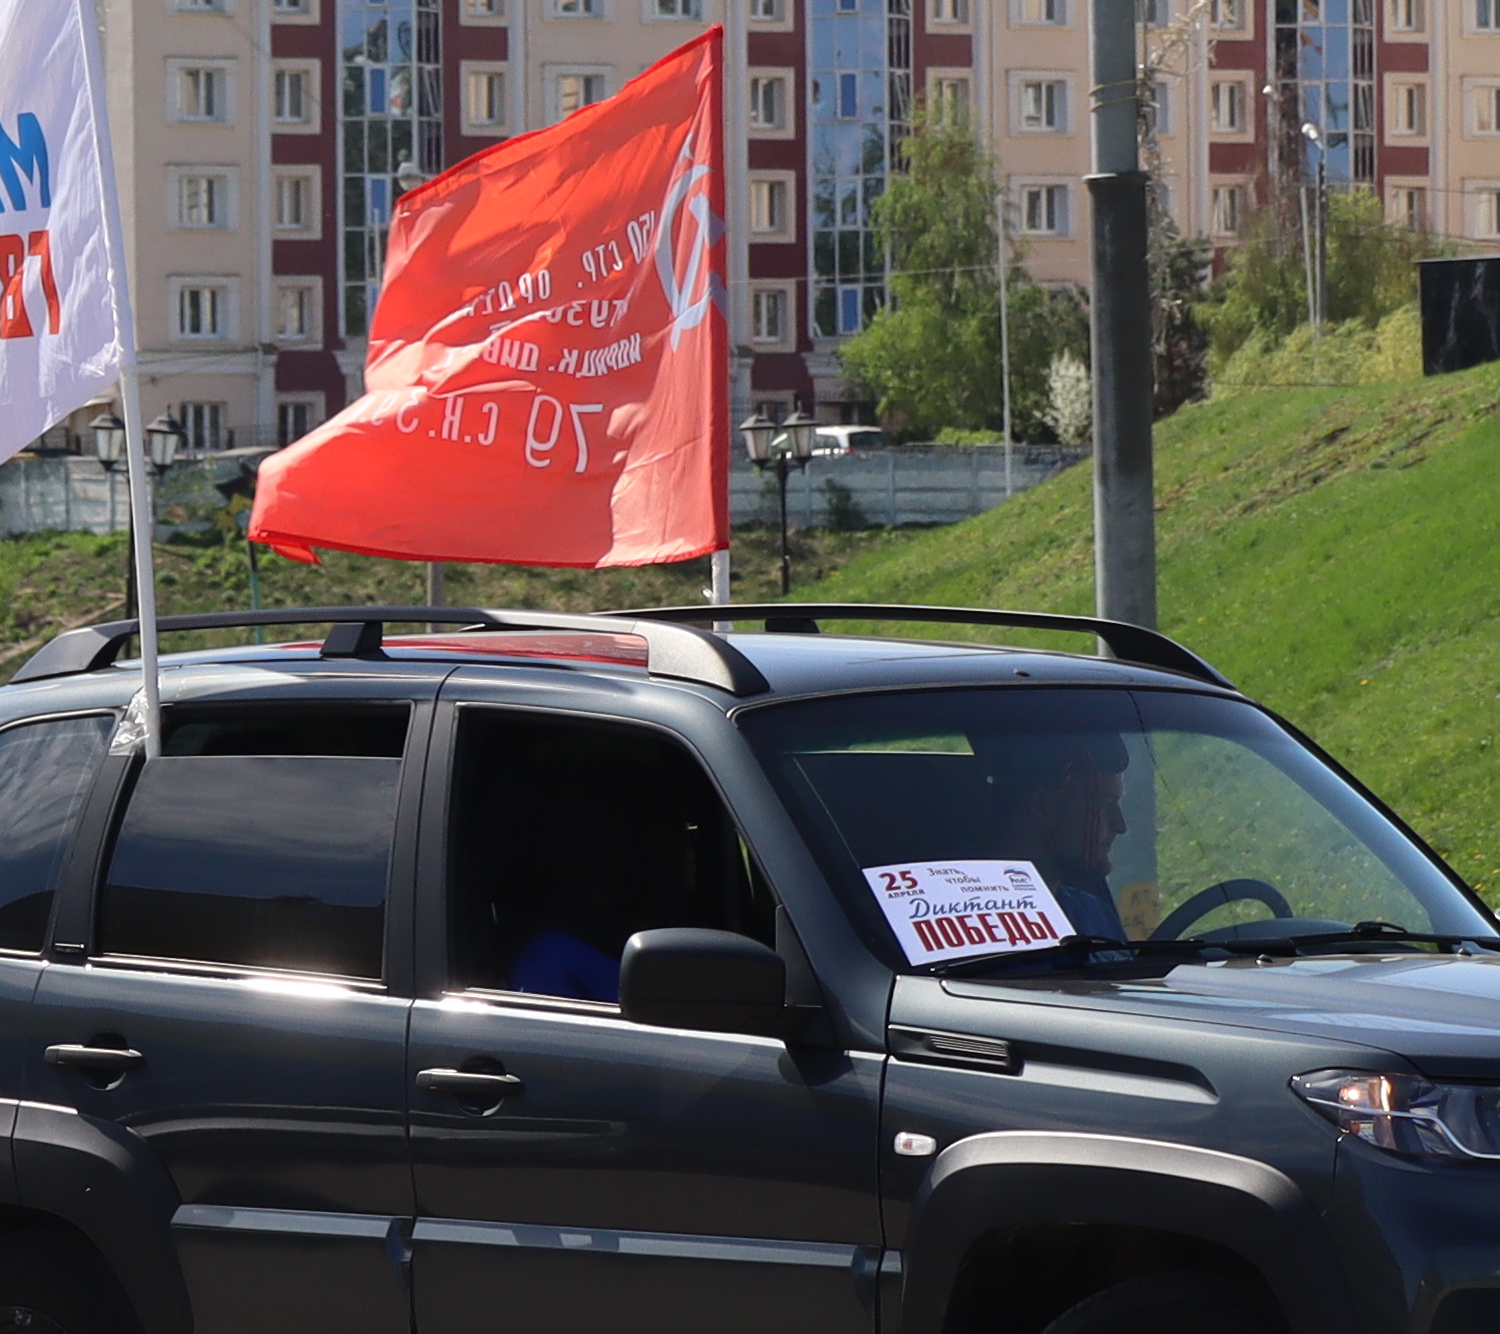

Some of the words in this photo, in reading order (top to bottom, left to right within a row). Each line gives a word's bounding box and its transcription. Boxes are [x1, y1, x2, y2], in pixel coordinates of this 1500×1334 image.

[878, 870, 918, 892] 25
[888, 889, 926, 900] АПРЕЛЯ
[909, 895, 1037, 919] Диктант
[911, 911, 1060, 953] ПОБЕДЫ
